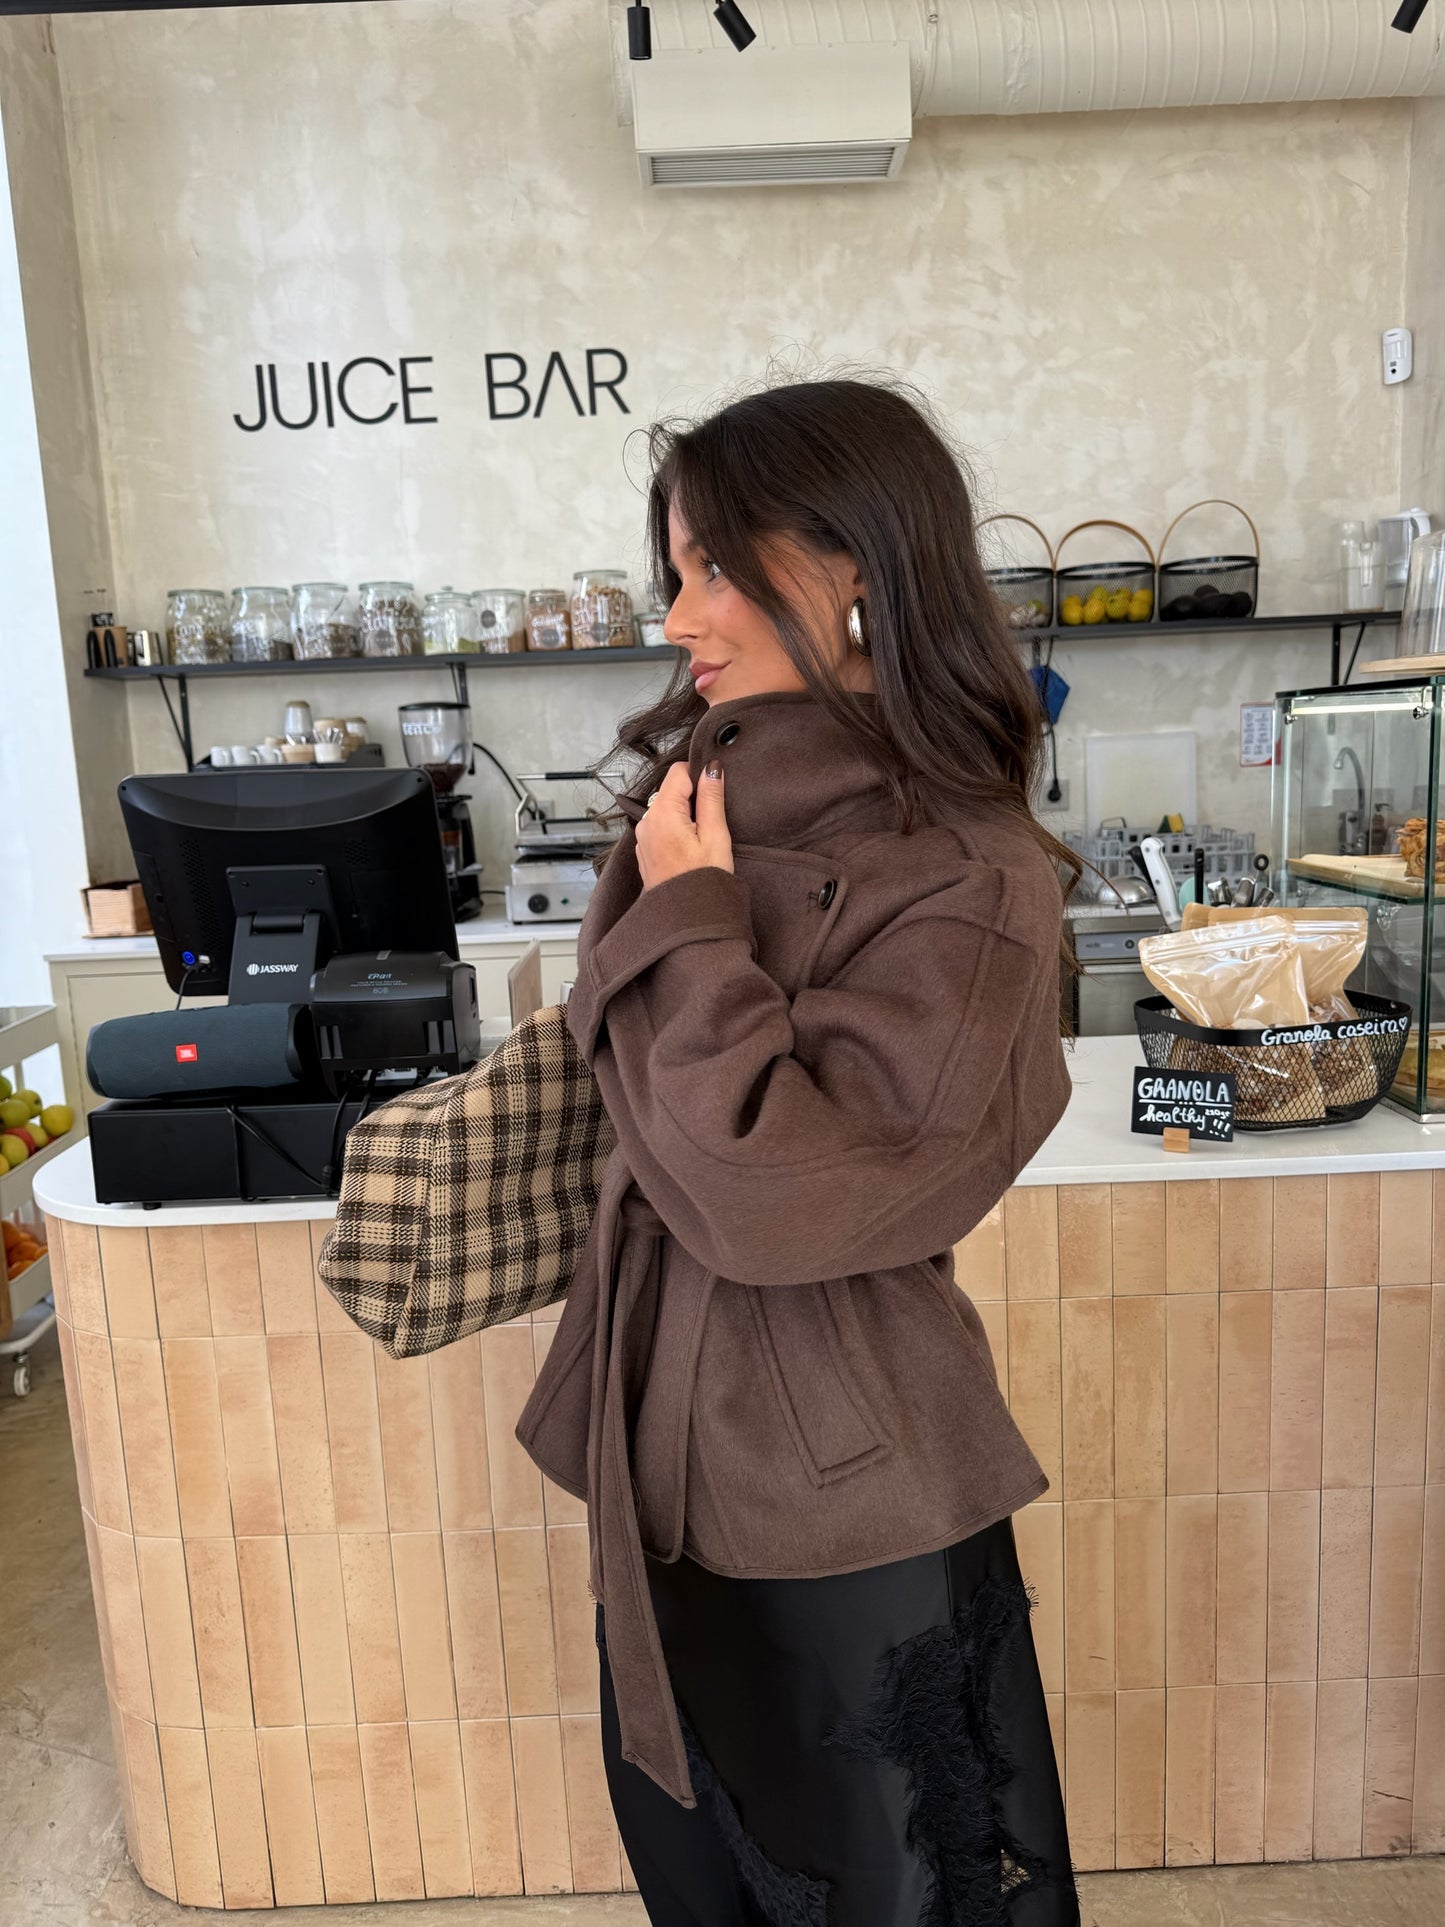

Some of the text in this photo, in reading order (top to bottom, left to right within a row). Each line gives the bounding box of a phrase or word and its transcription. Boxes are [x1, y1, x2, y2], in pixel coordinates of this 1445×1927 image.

[234, 348, 631, 432] JUICE BAR
[260, 964, 299, 974] JASSWAY
[1261, 1018, 1399, 1046] Granola caseira
[1138, 1077, 1230, 1102] GRANOLA
[1139, 1104, 1205, 1131] healthy
